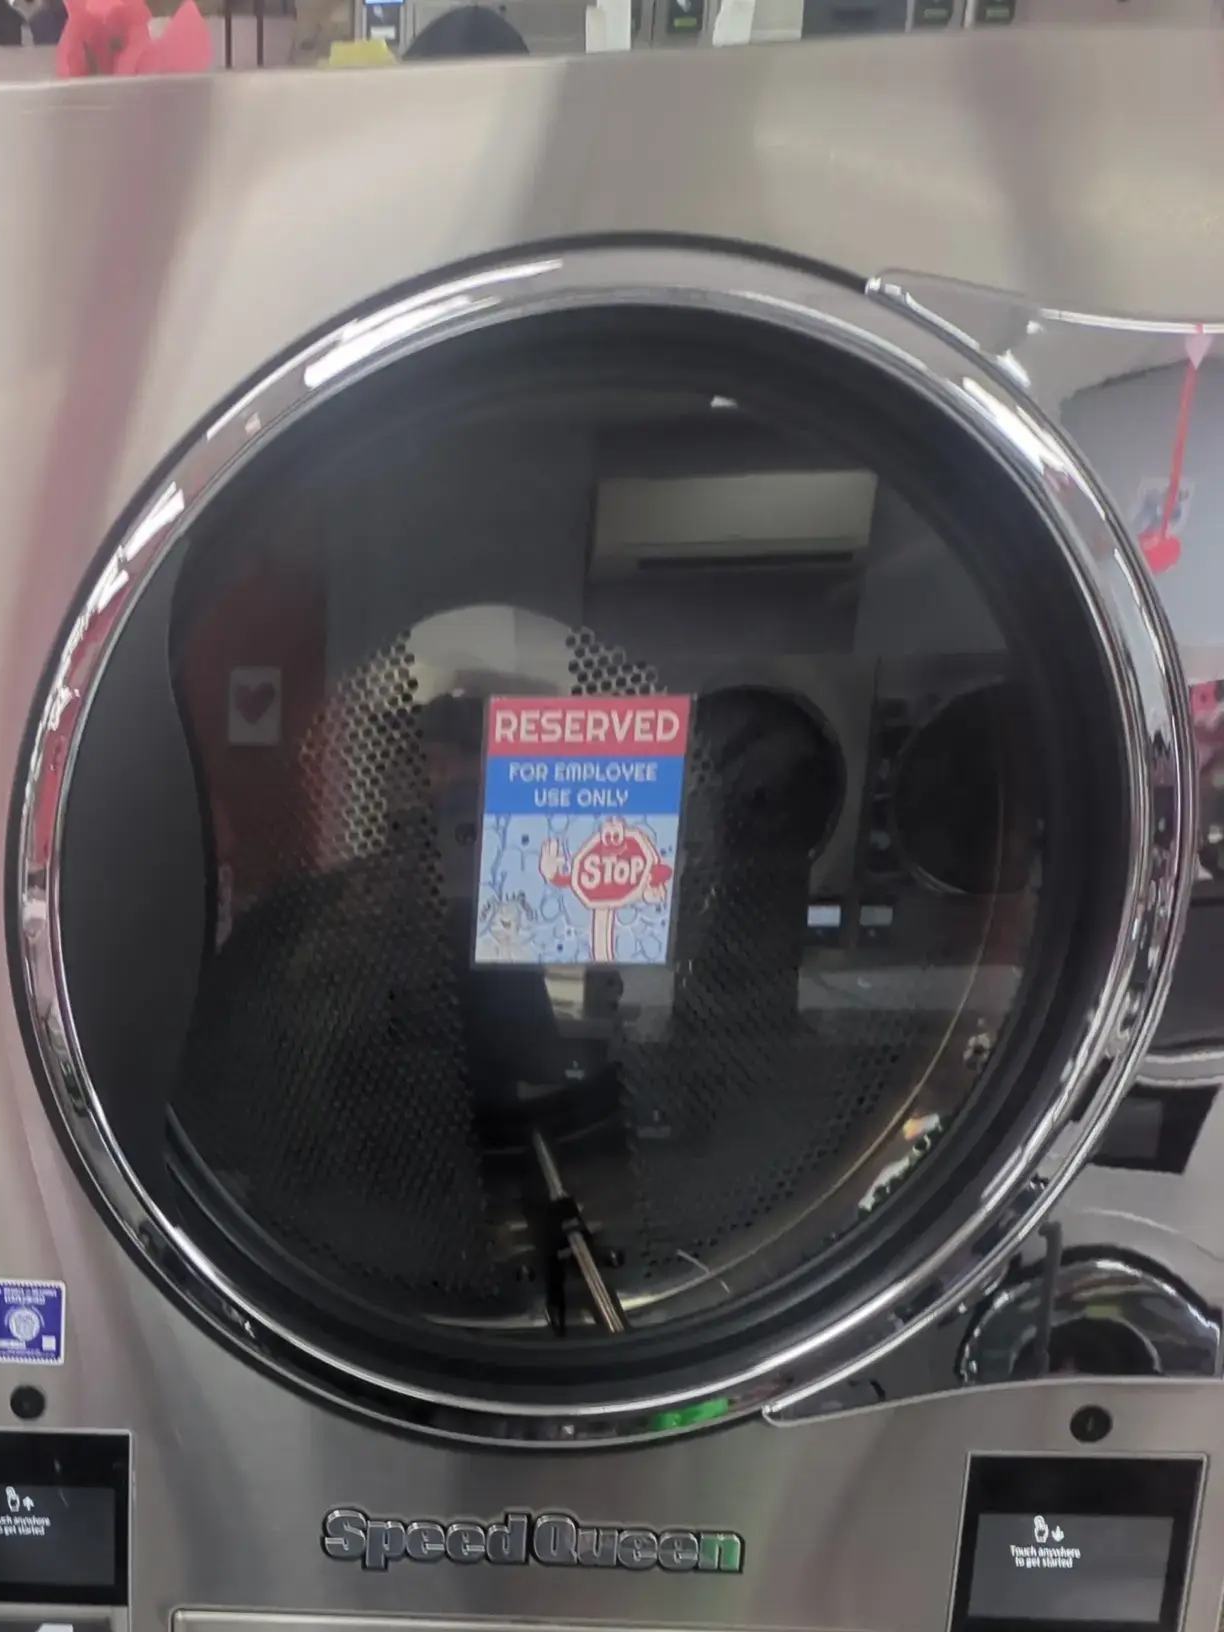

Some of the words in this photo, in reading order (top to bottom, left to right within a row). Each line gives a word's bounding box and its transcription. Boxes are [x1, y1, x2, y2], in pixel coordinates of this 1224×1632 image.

[494, 709, 680, 744] RESERVED
[508, 761, 548, 782] FOR
[554, 761, 658, 782] EMPLOYEE
[534, 788, 571, 808] USE
[577, 788, 628, 808] ONLY
